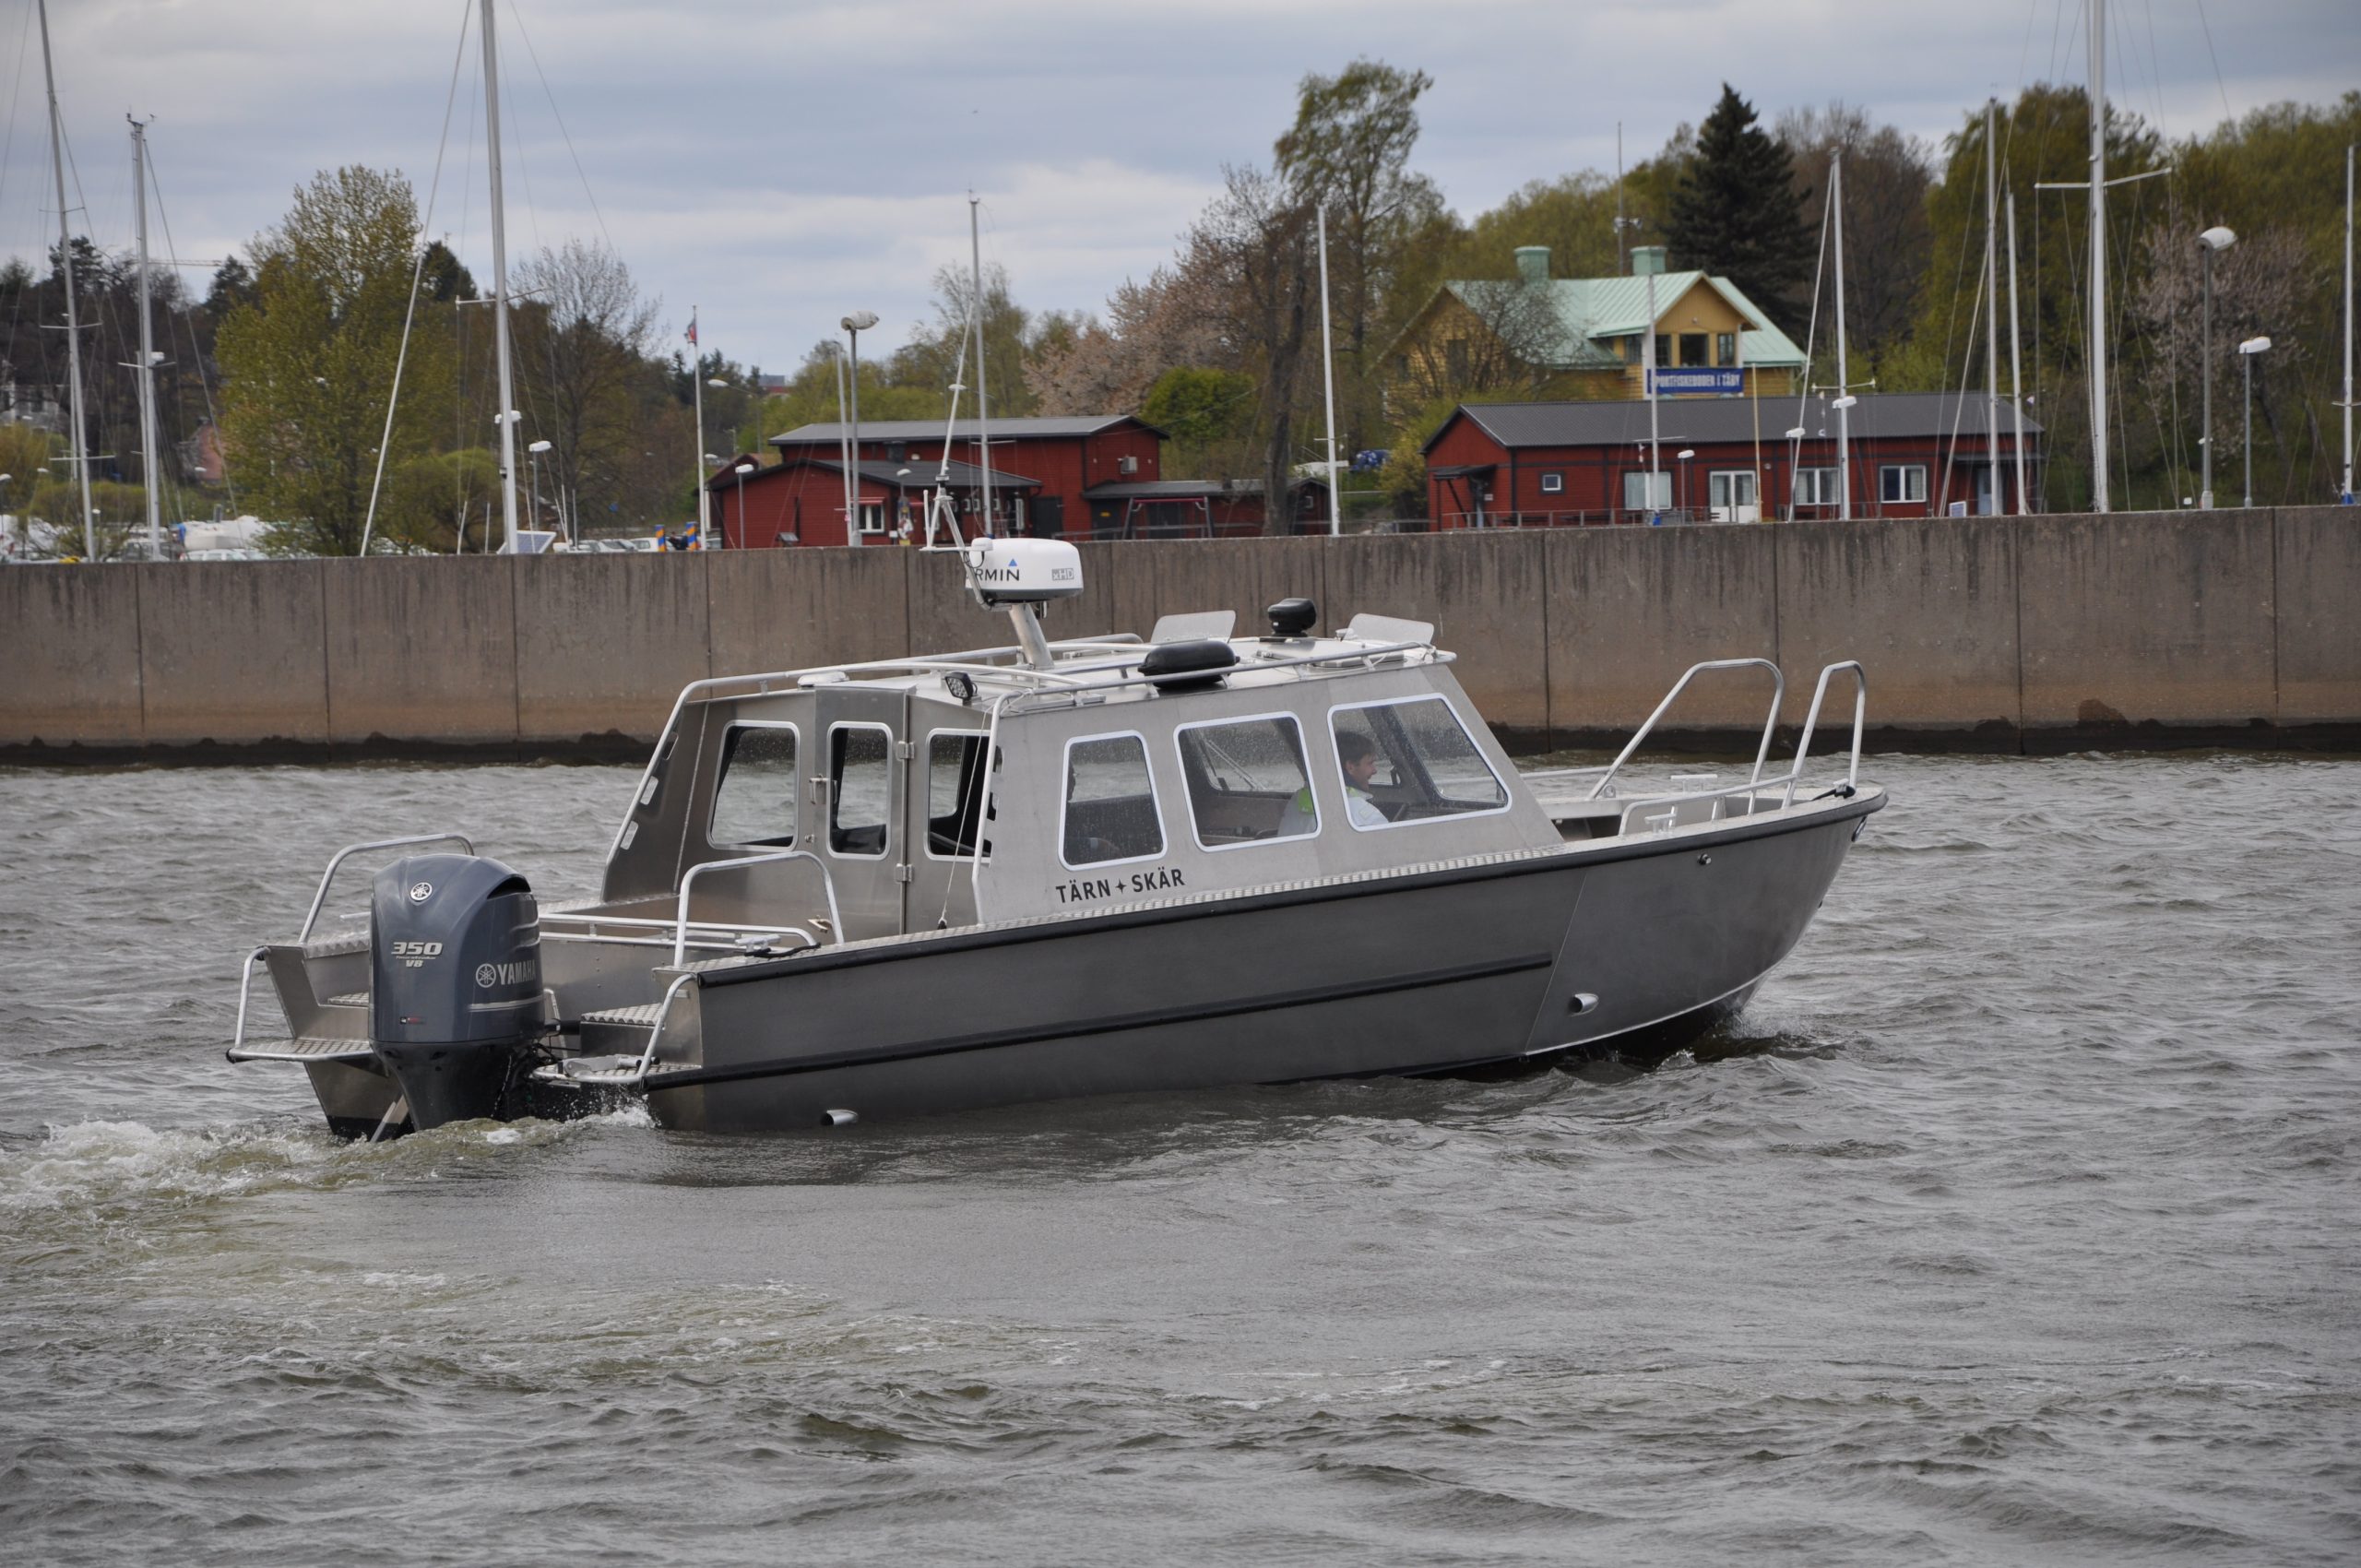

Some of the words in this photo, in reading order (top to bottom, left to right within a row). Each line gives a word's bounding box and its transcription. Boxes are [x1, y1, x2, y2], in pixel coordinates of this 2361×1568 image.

[966, 568, 1020, 581] RMIN
[1056, 879, 1111, 903] TÄRN
[1131, 866, 1186, 893] SKÄR
[391, 942, 443, 956] 350
[406, 959, 424, 968] V8
[497, 959, 536, 985] YAMAHA
